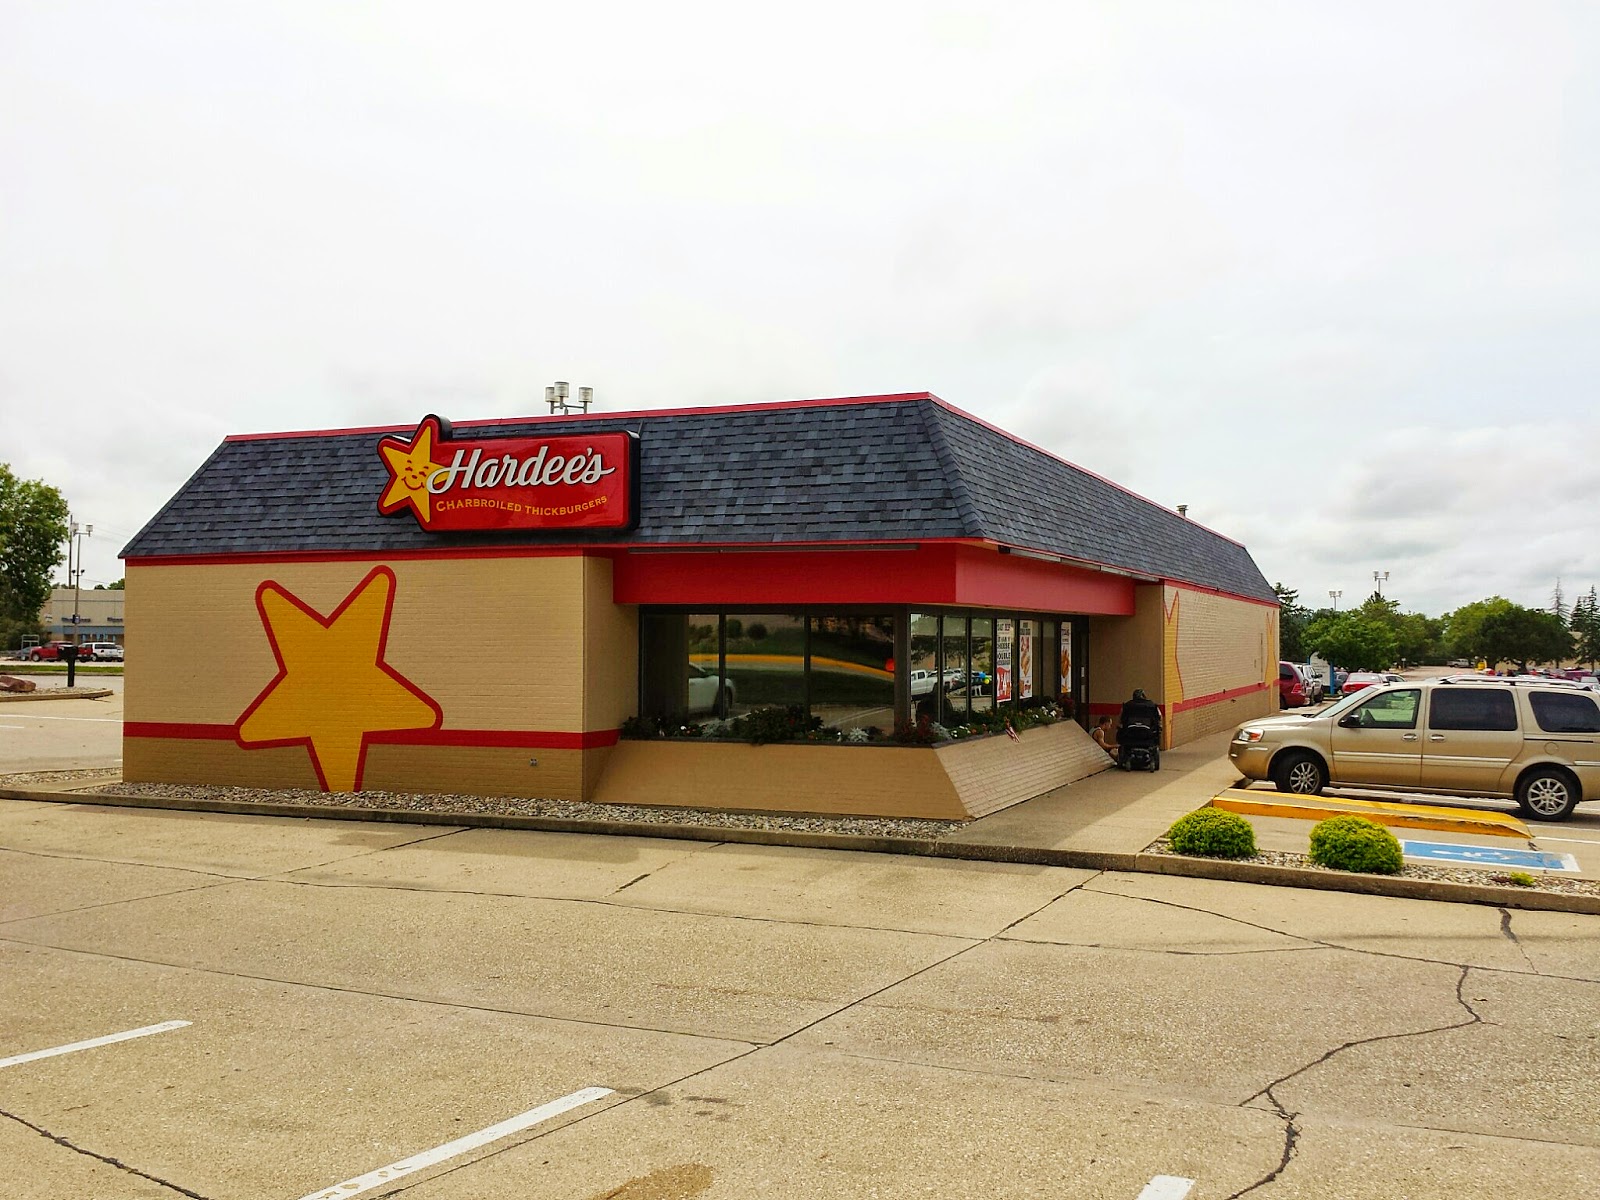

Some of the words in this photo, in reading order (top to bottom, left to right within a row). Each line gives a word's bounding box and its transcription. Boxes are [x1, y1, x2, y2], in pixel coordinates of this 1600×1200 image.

[426, 446, 615, 494] Hardee's
[436, 498, 522, 512] CHARBROILED
[524, 495, 608, 516] THICKBURGERS
